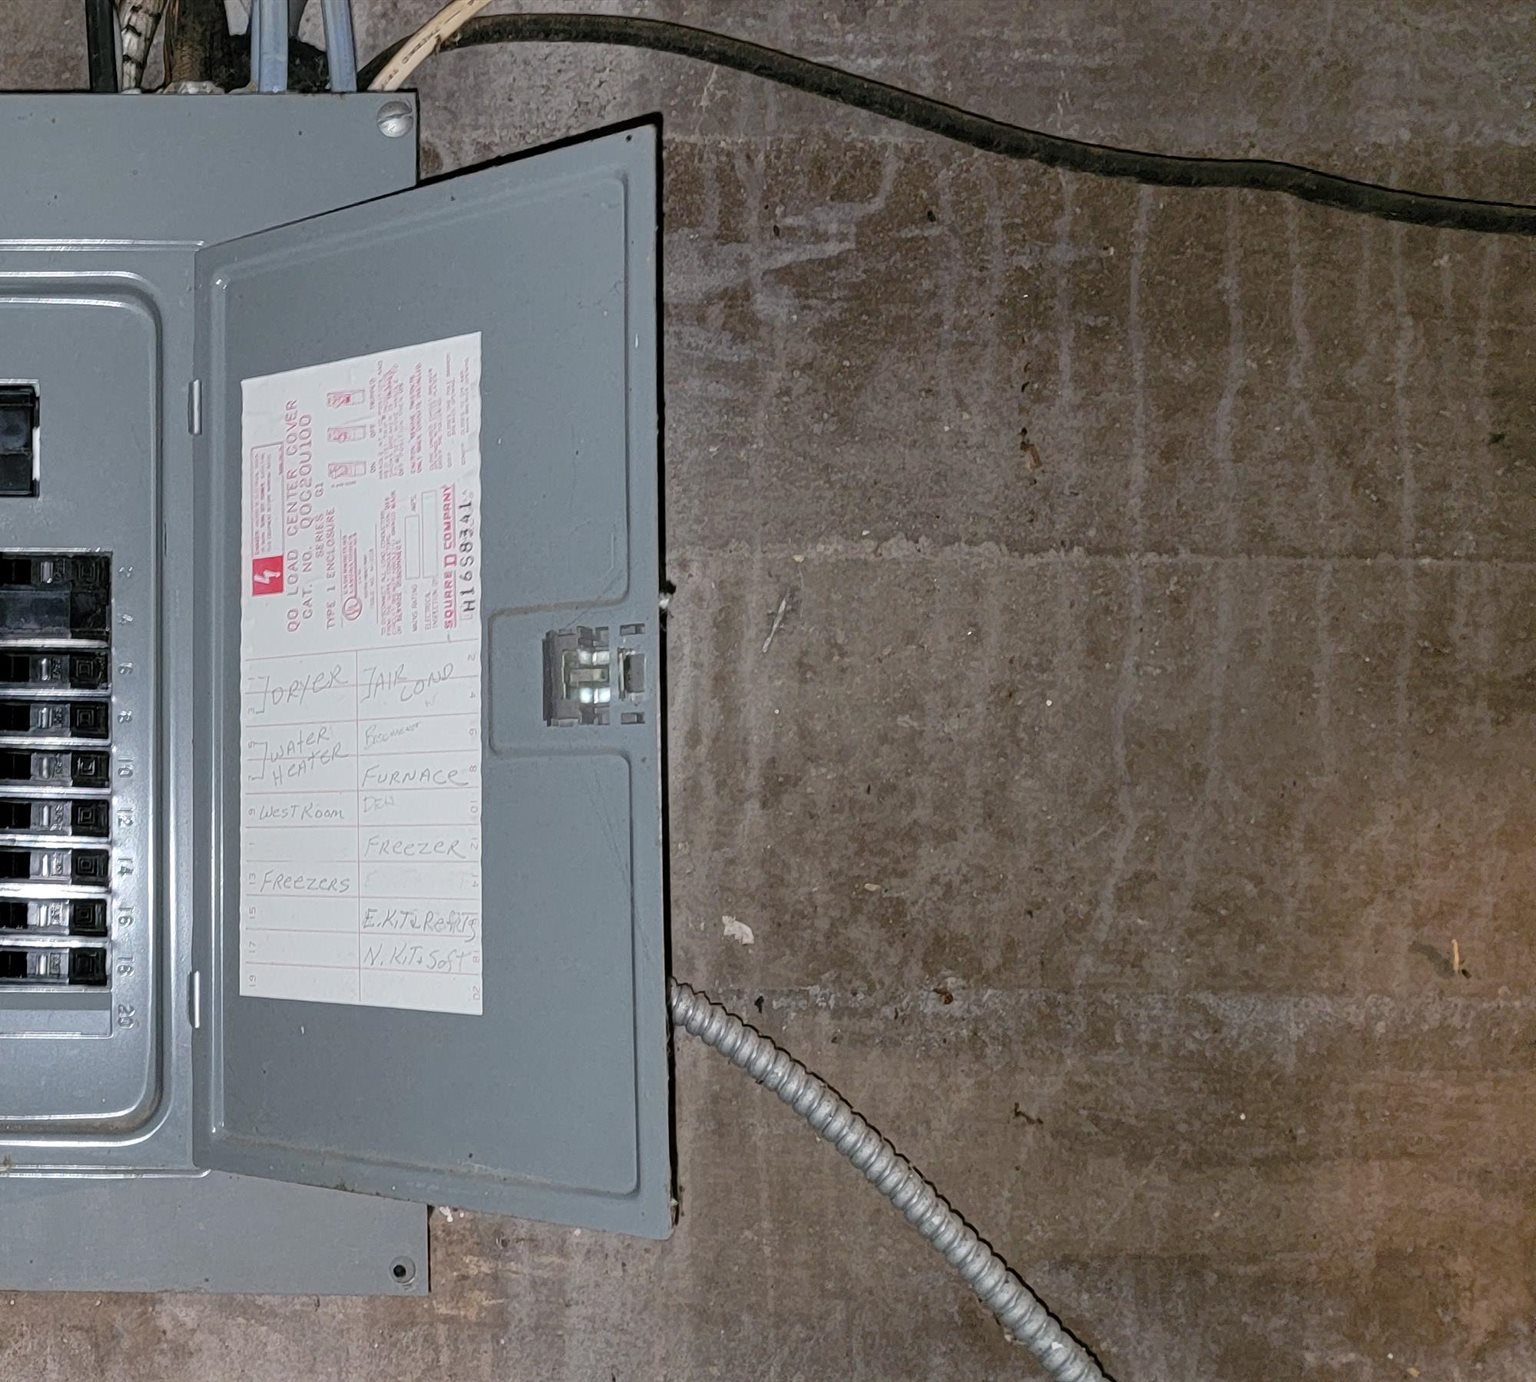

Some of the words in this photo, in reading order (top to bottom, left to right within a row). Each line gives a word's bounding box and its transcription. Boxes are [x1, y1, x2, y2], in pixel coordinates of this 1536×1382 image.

[285, 399, 298, 456] COVER
[287, 469, 299, 536] CENTER
[442, 485, 454, 550] COMPANY
[315, 513, 324, 557] SERIES
[325, 507, 335, 580] ENCLOSURE
[287, 550, 299, 596] LOAD
[302, 546, 312, 572] NO.
[444, 554, 457, 567] D
[302, 584, 312, 620] CAT.
[444, 571, 455, 629] SQUARE
[287, 609, 300, 632] QO
[326, 601, 335, 629] TYPE
[118, 809, 133, 827] 12
[118, 858, 133, 877] 14
[118, 906, 134, 927] 16
[117, 956, 134, 977] 18
[117, 1004, 135, 1029] 20
